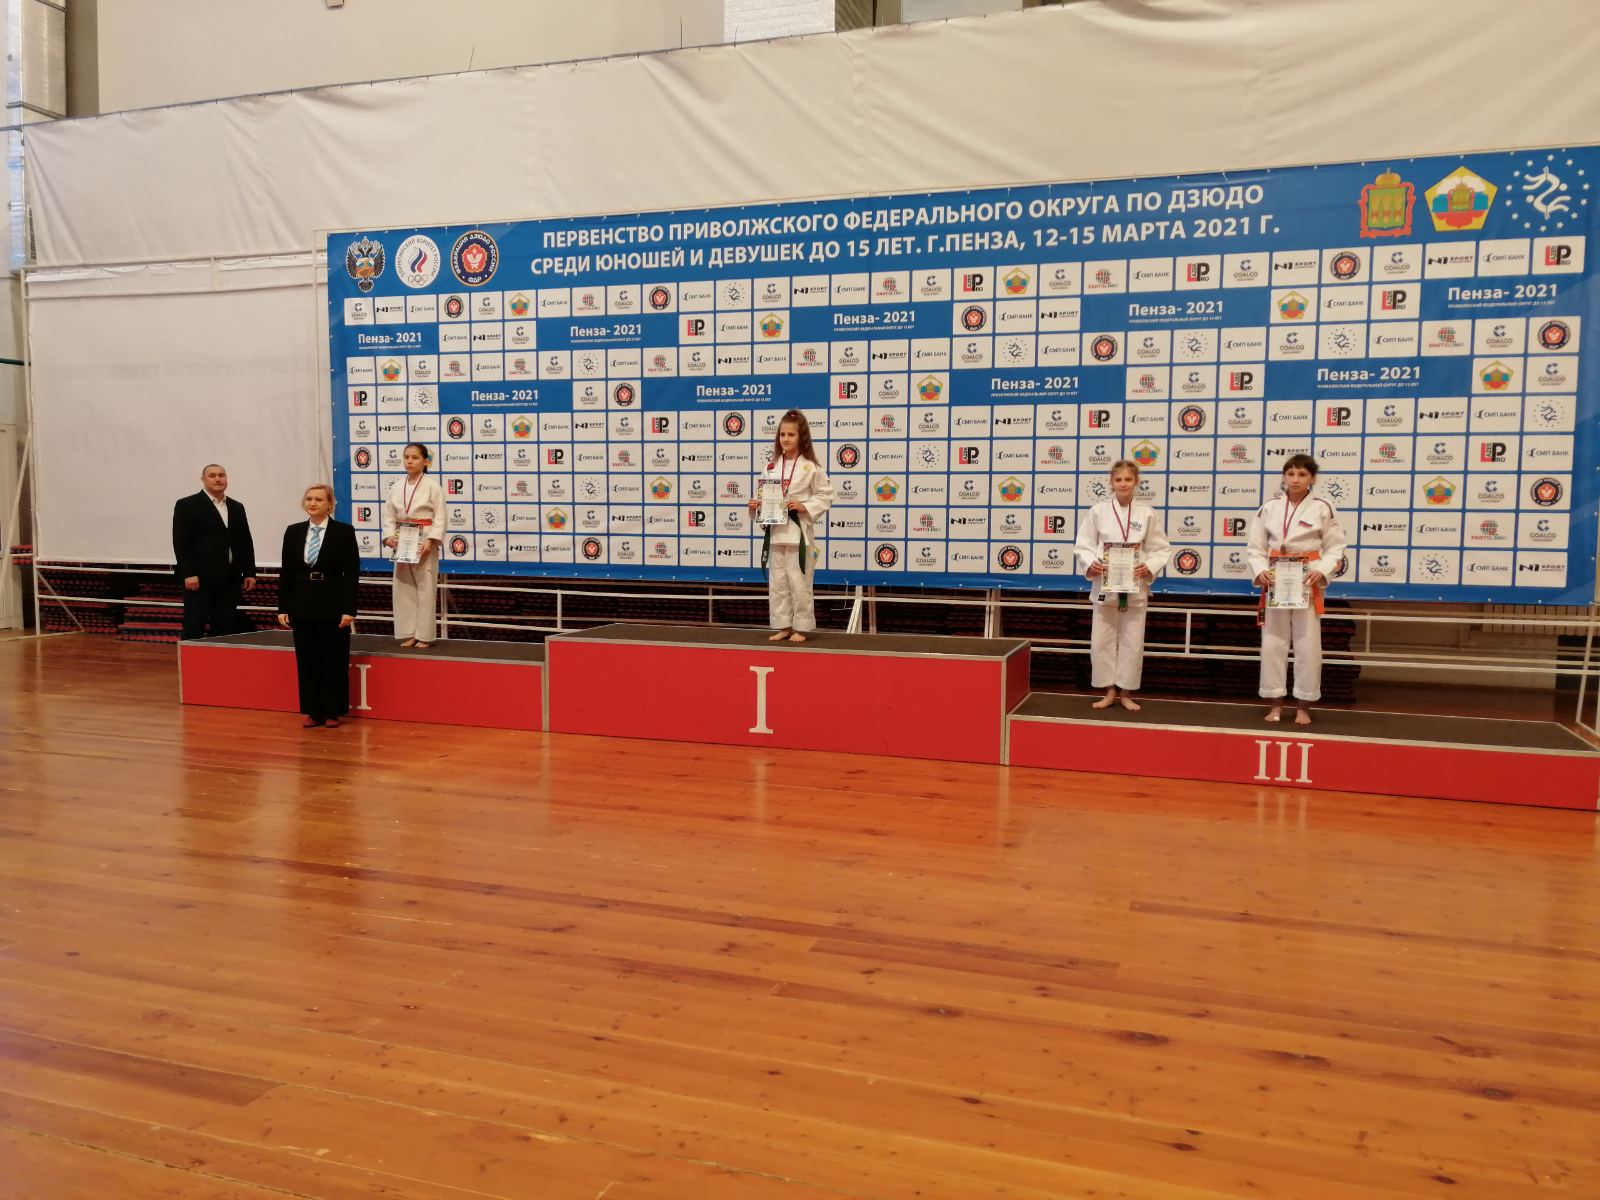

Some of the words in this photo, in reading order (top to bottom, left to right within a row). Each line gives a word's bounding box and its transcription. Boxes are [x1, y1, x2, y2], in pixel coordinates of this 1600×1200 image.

[543, 225, 664, 248] ПЕРВЕНСТВО
[669, 213, 838, 240] ПРИВОЛЖСКОГО
[844, 201, 1023, 231] ФЕДЕРАЛЬНОГО
[1029, 195, 1120, 218] ОКРУГА
[1127, 192, 1162, 212] ПО
[1168, 185, 1264, 213] ДЗЮДО
[531, 256, 590, 276] СРЕДИ
[596, 247, 684, 271] ЮНОШЕЙ
[690, 249, 703, 266] И
[708, 243, 804, 268] ДЕВУШЕК
[809, 241, 840, 263] ДО
[847, 240, 869, 257] 15
[875, 236, 921, 256] ЛЕТ.
[928, 230, 1025, 253] Г.ПЕНЗА,
[1034, 226, 1095, 247] 12-15
[1102, 220, 1186, 243] МАРТА
[1193, 217, 1249, 238] 2021
[1260, 215, 1280, 234] Г.
[1448, 287, 1509, 300] Пенза-
[1515, 284, 1557, 298] 2021
[1129, 304, 1182, 316] Пенза-
[1186, 301, 1223, 314] 2021
[834, 313, 880, 325] Пенза-
[883, 311, 915, 323] 2021
[358, 334, 393, 343] Пенза-
[396, 332, 421, 343] 2021
[571, 326, 610, 337] Пенза-
[614, 324, 641, 335] 2021
[1317, 368, 1375, 381] Пенза-
[1380, 366, 1420, 380] 2021
[697, 385, 739, 396] Пенза-
[742, 384, 771, 395] 2021
[992, 378, 1040, 390] Пенза-
[1044, 377, 1078, 389] 2021
[471, 391, 509, 401] Пенза-
[512, 390, 538, 400] 2021
[749, 666, 774, 734] I
[1254, 740, 1314, 783] III
